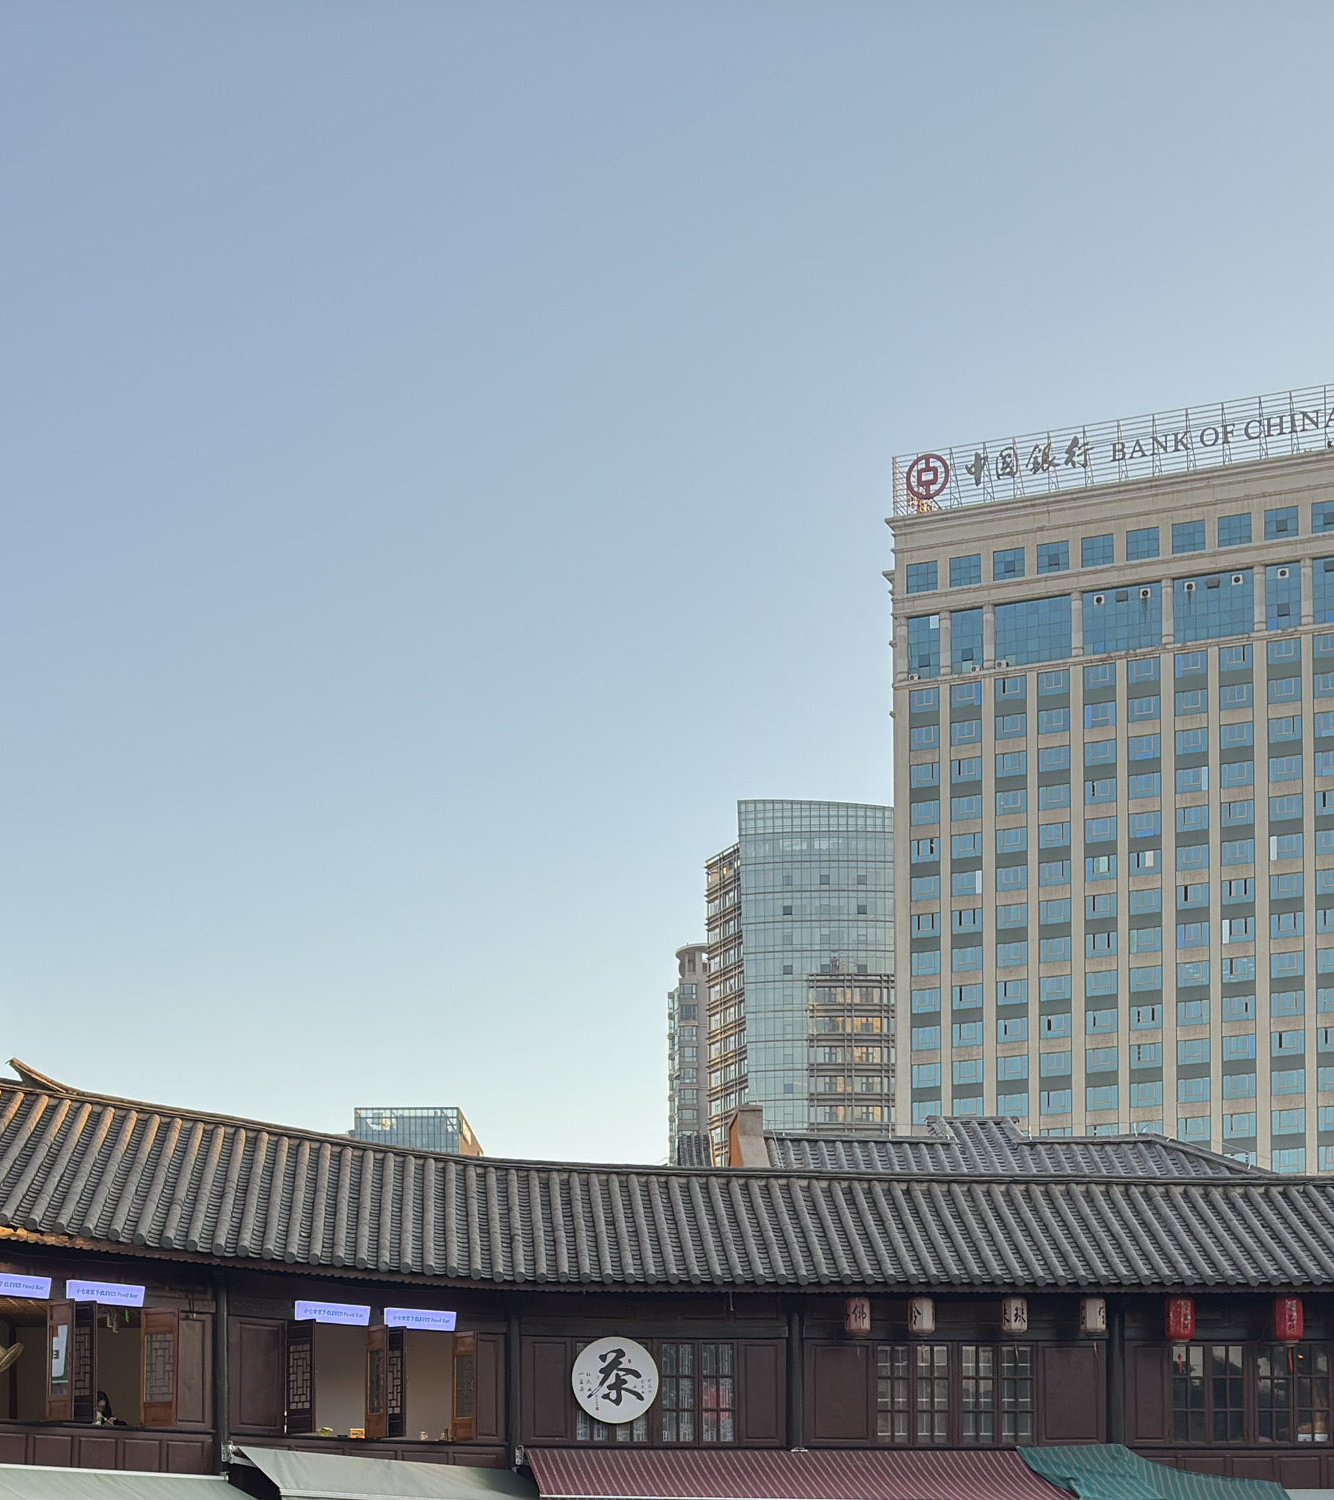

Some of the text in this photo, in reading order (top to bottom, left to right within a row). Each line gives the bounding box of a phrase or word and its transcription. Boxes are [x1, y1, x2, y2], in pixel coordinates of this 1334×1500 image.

[1110, 430, 1192, 462] BANK
[1200, 424, 1236, 447] OF
[587, 1348, 645, 1406] 茶
